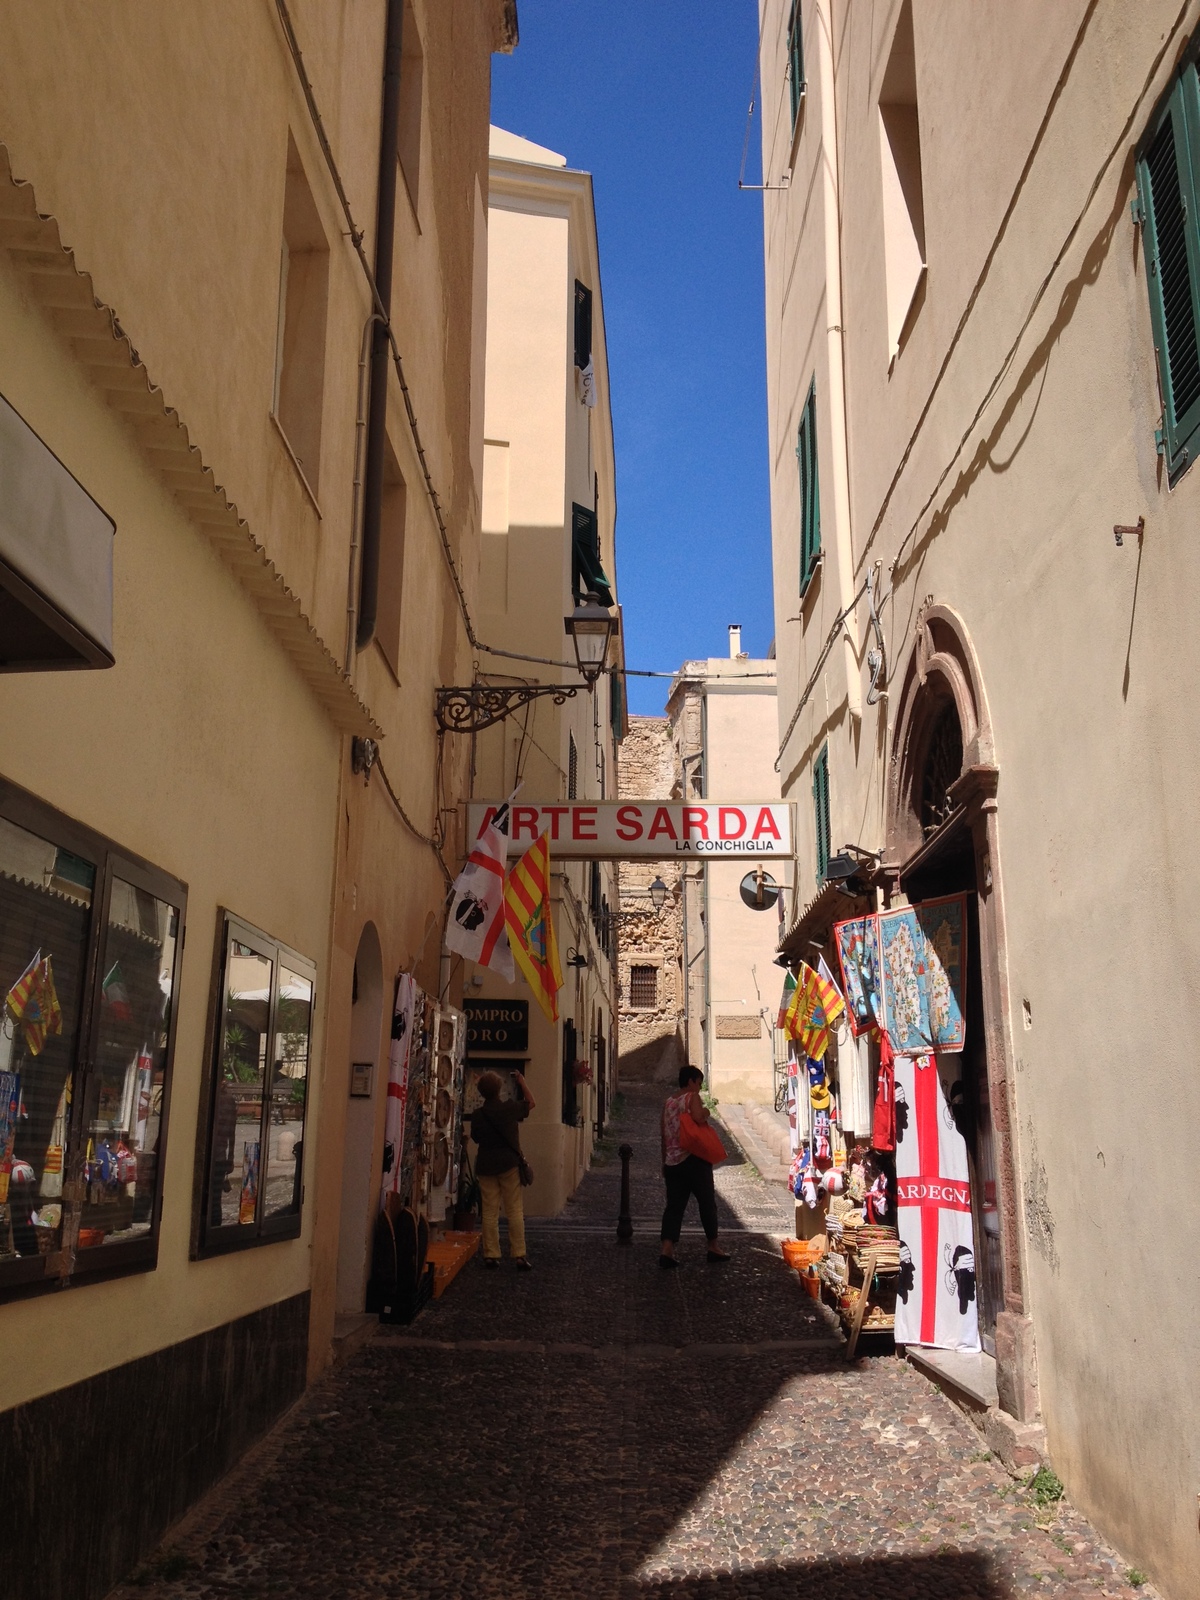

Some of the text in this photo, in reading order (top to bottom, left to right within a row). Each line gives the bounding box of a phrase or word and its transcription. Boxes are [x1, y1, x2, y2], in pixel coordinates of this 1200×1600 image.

[616, 806, 781, 841] SARDA
[675, 840, 774, 851] LA CONCHIGLIA
[464, 1009, 523, 1022] OMPRO
